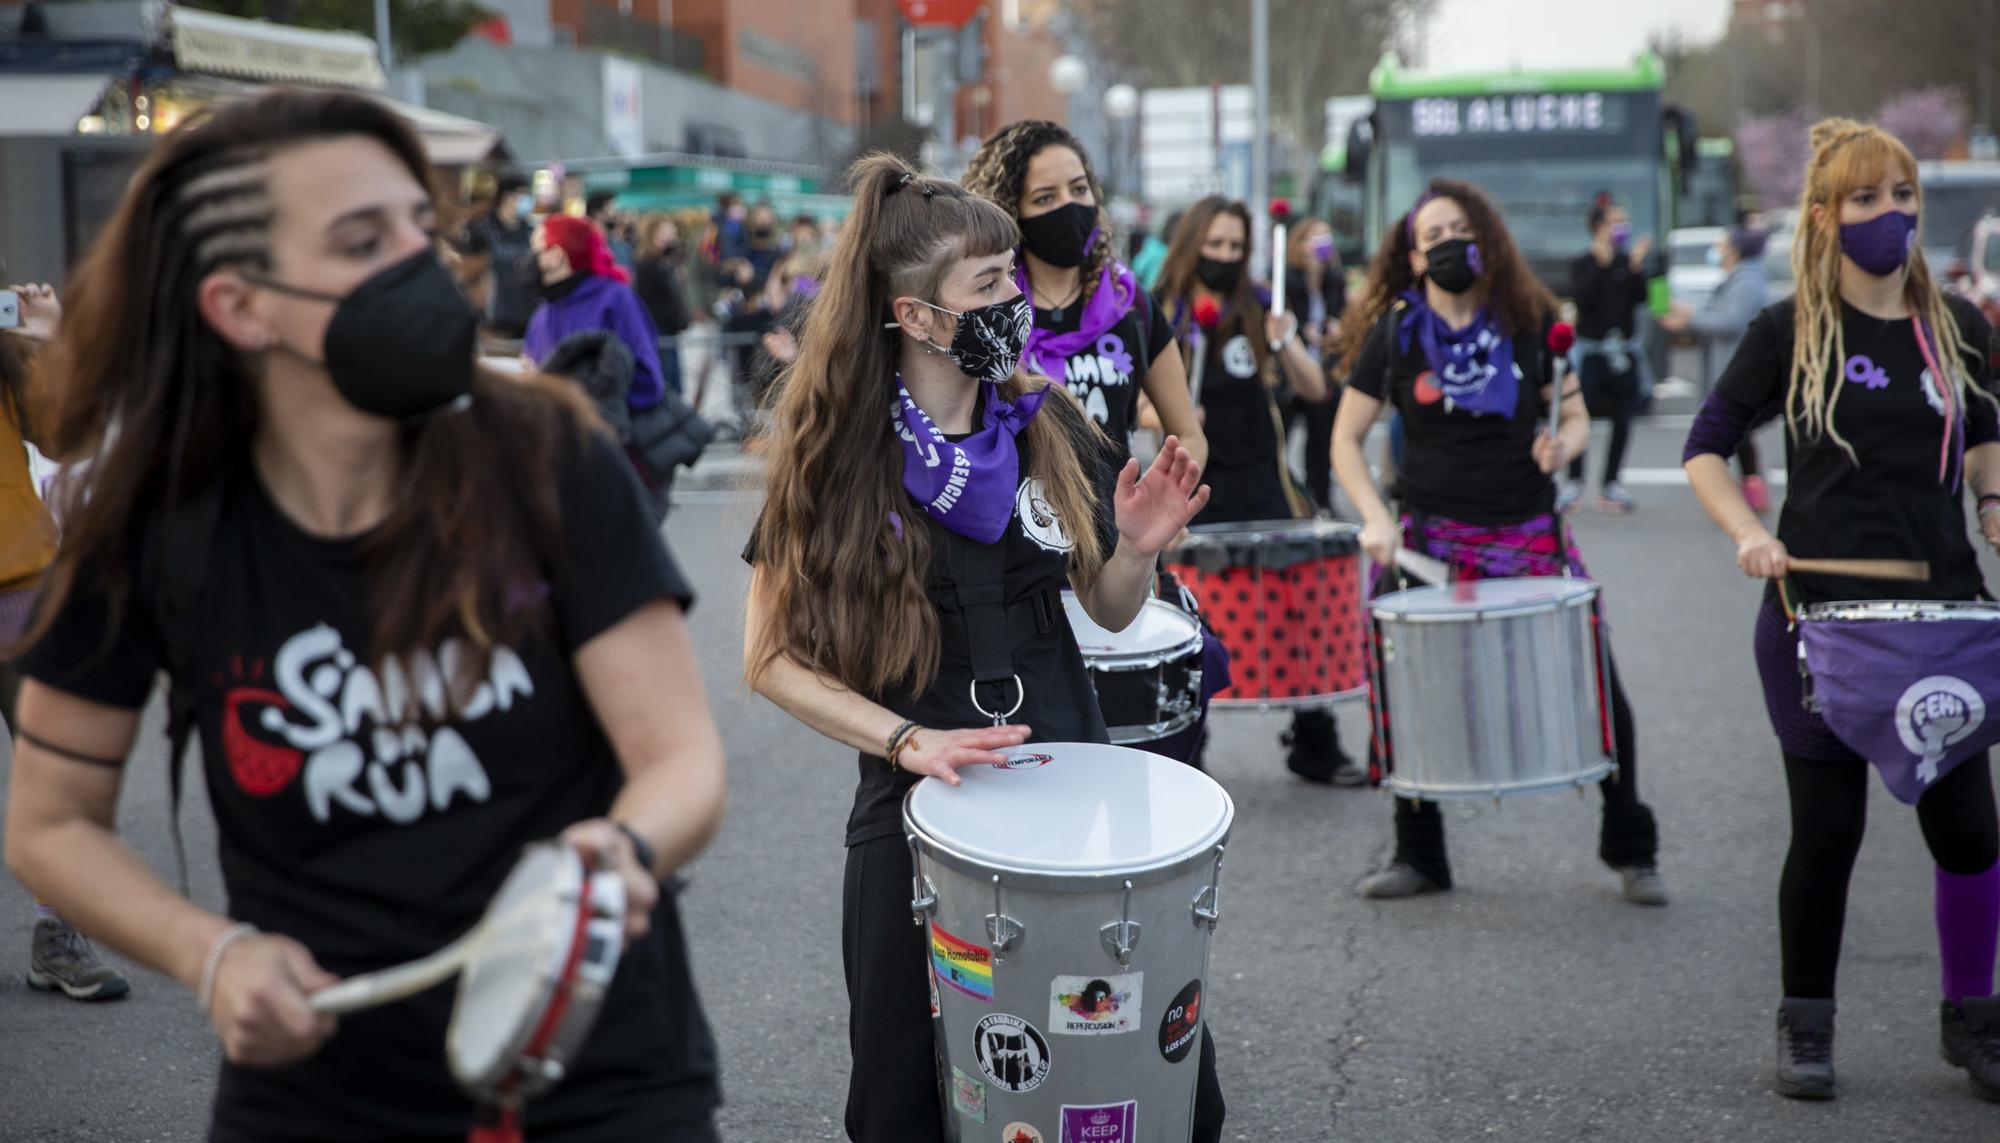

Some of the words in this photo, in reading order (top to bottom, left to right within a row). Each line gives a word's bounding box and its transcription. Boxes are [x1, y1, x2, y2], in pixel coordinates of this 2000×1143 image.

[1467, 92, 1603, 133] ALUCHE
[931, 447, 971, 514] ESENCIAL
[303, 725, 492, 825] RUA
[1168, 1005, 1183, 1023] no
[1165, 1039, 1181, 1054] LOS
[1081, 1124, 1119, 1137] KEEP
